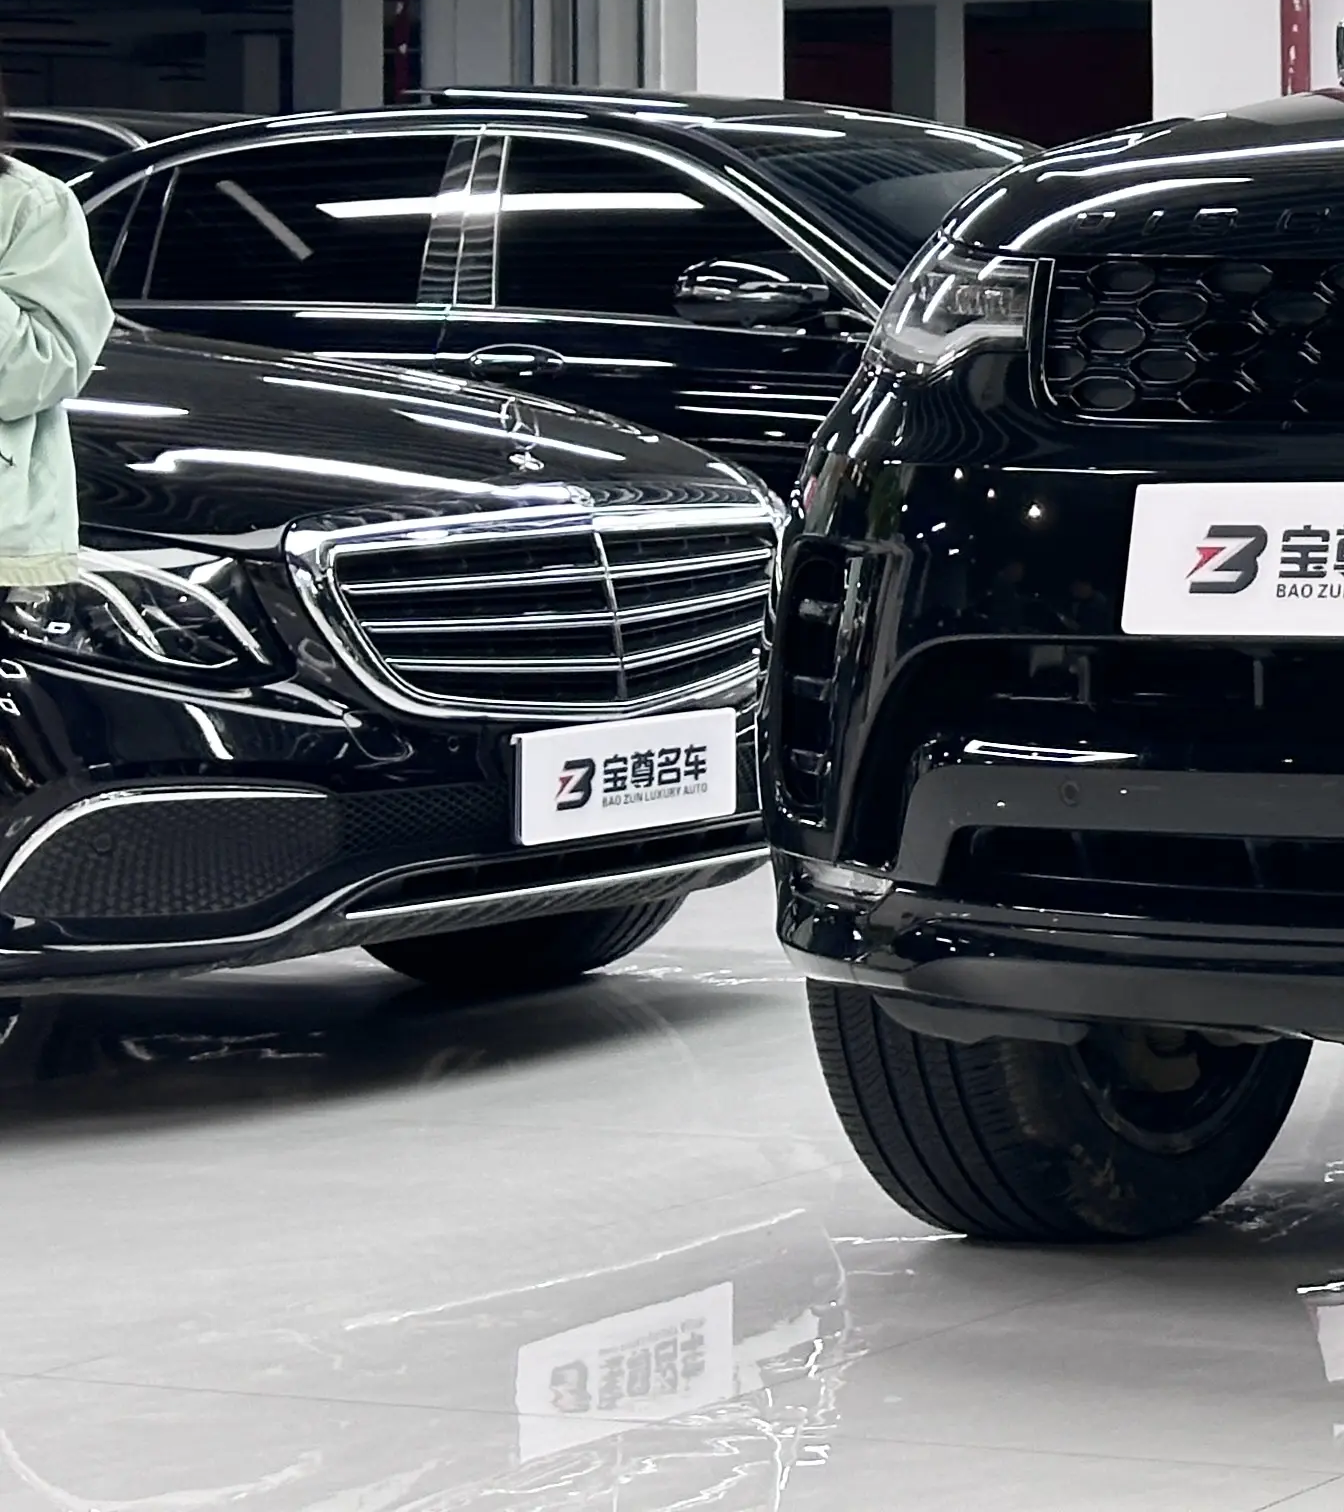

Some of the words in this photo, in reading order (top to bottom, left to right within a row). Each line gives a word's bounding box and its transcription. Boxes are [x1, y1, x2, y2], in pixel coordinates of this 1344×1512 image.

[1276, 583, 1314, 599] BAO
[603, 744, 707, 793] 宝尊名车
[602, 794, 622, 808] BAO
[623, 792, 643, 805] ZUN
[645, 787, 681, 802] LUXURY
[684, 783, 708, 797] AUTO
